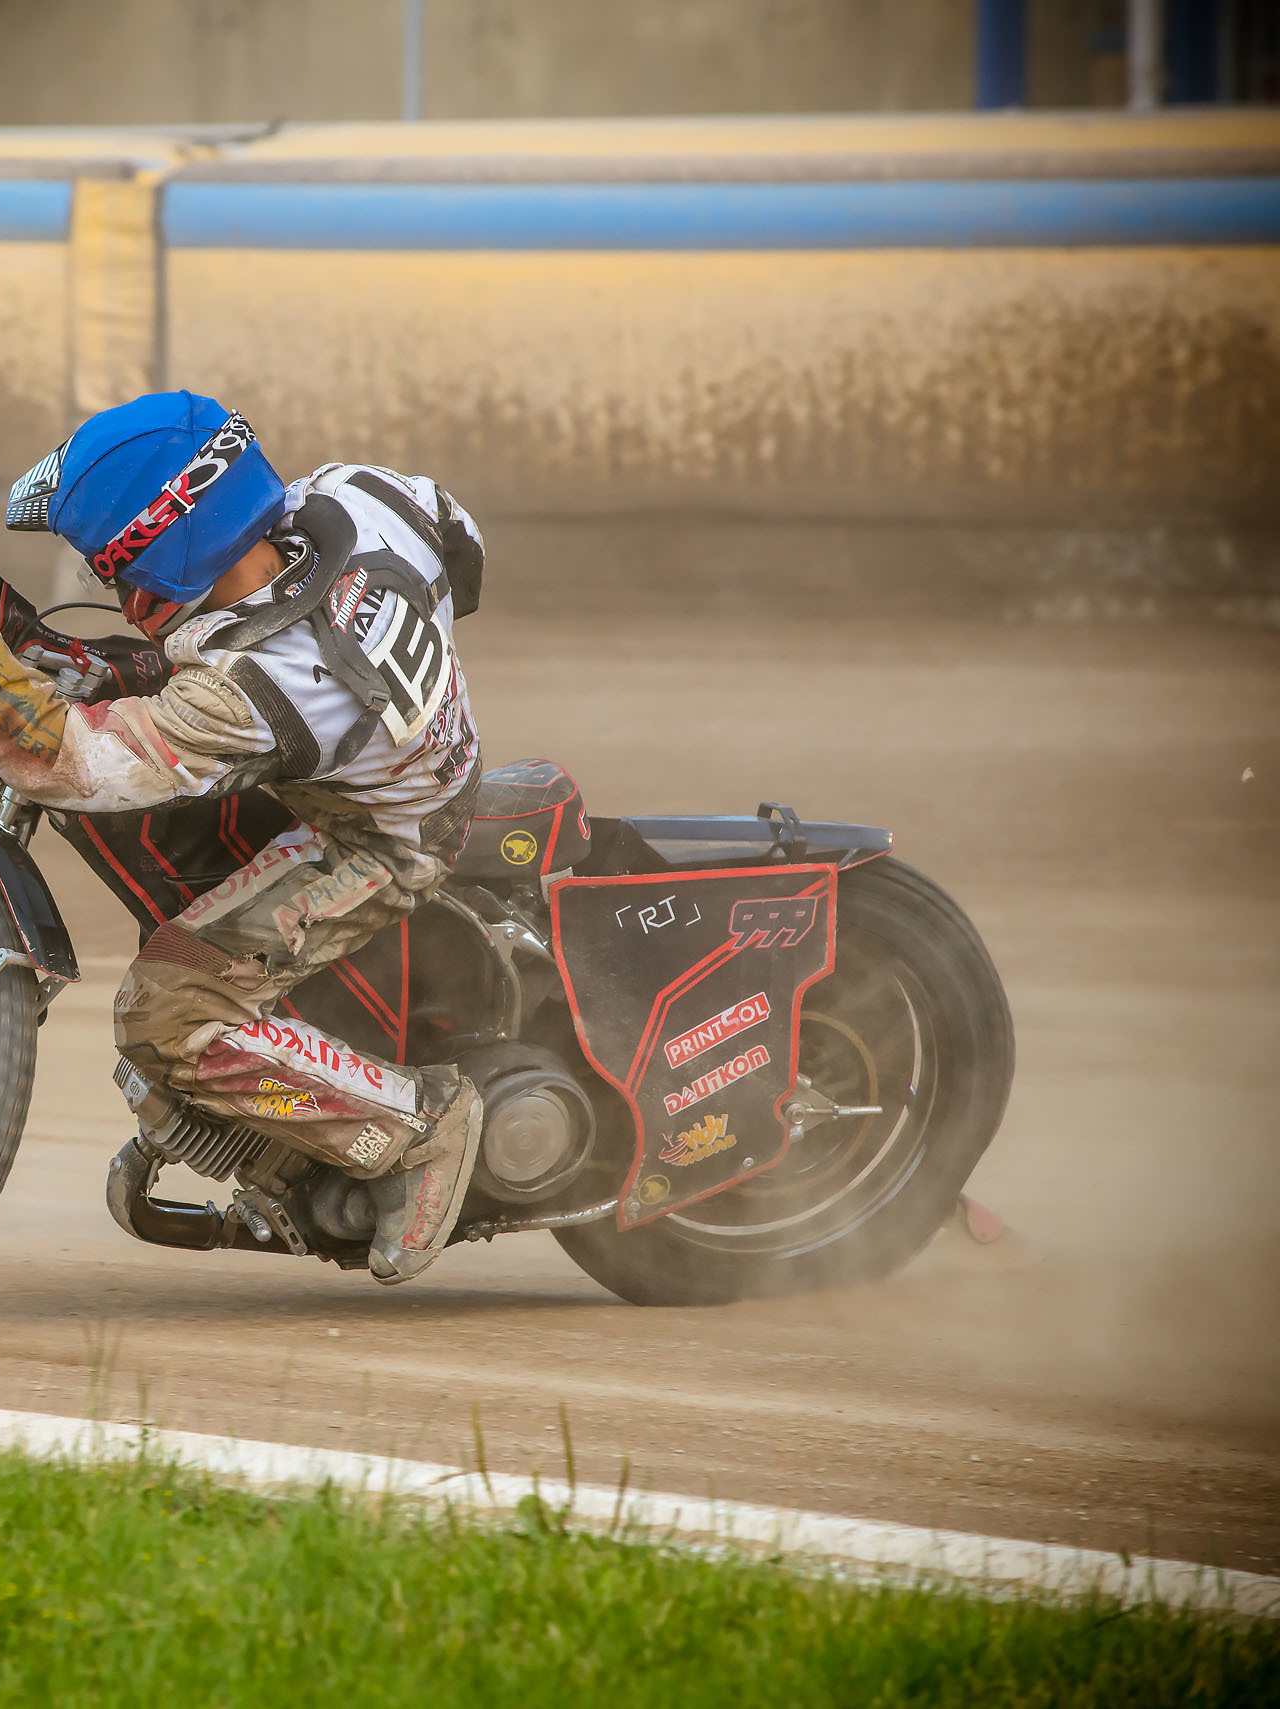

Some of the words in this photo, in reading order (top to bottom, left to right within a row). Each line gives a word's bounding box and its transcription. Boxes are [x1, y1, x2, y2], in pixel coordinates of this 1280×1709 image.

[94, 473, 196, 577] OAKLEY
[376, 598, 443, 727] 15
[669, 999, 767, 1060] PRINTSOL
[665, 1047, 768, 1114] DAUTKOM
